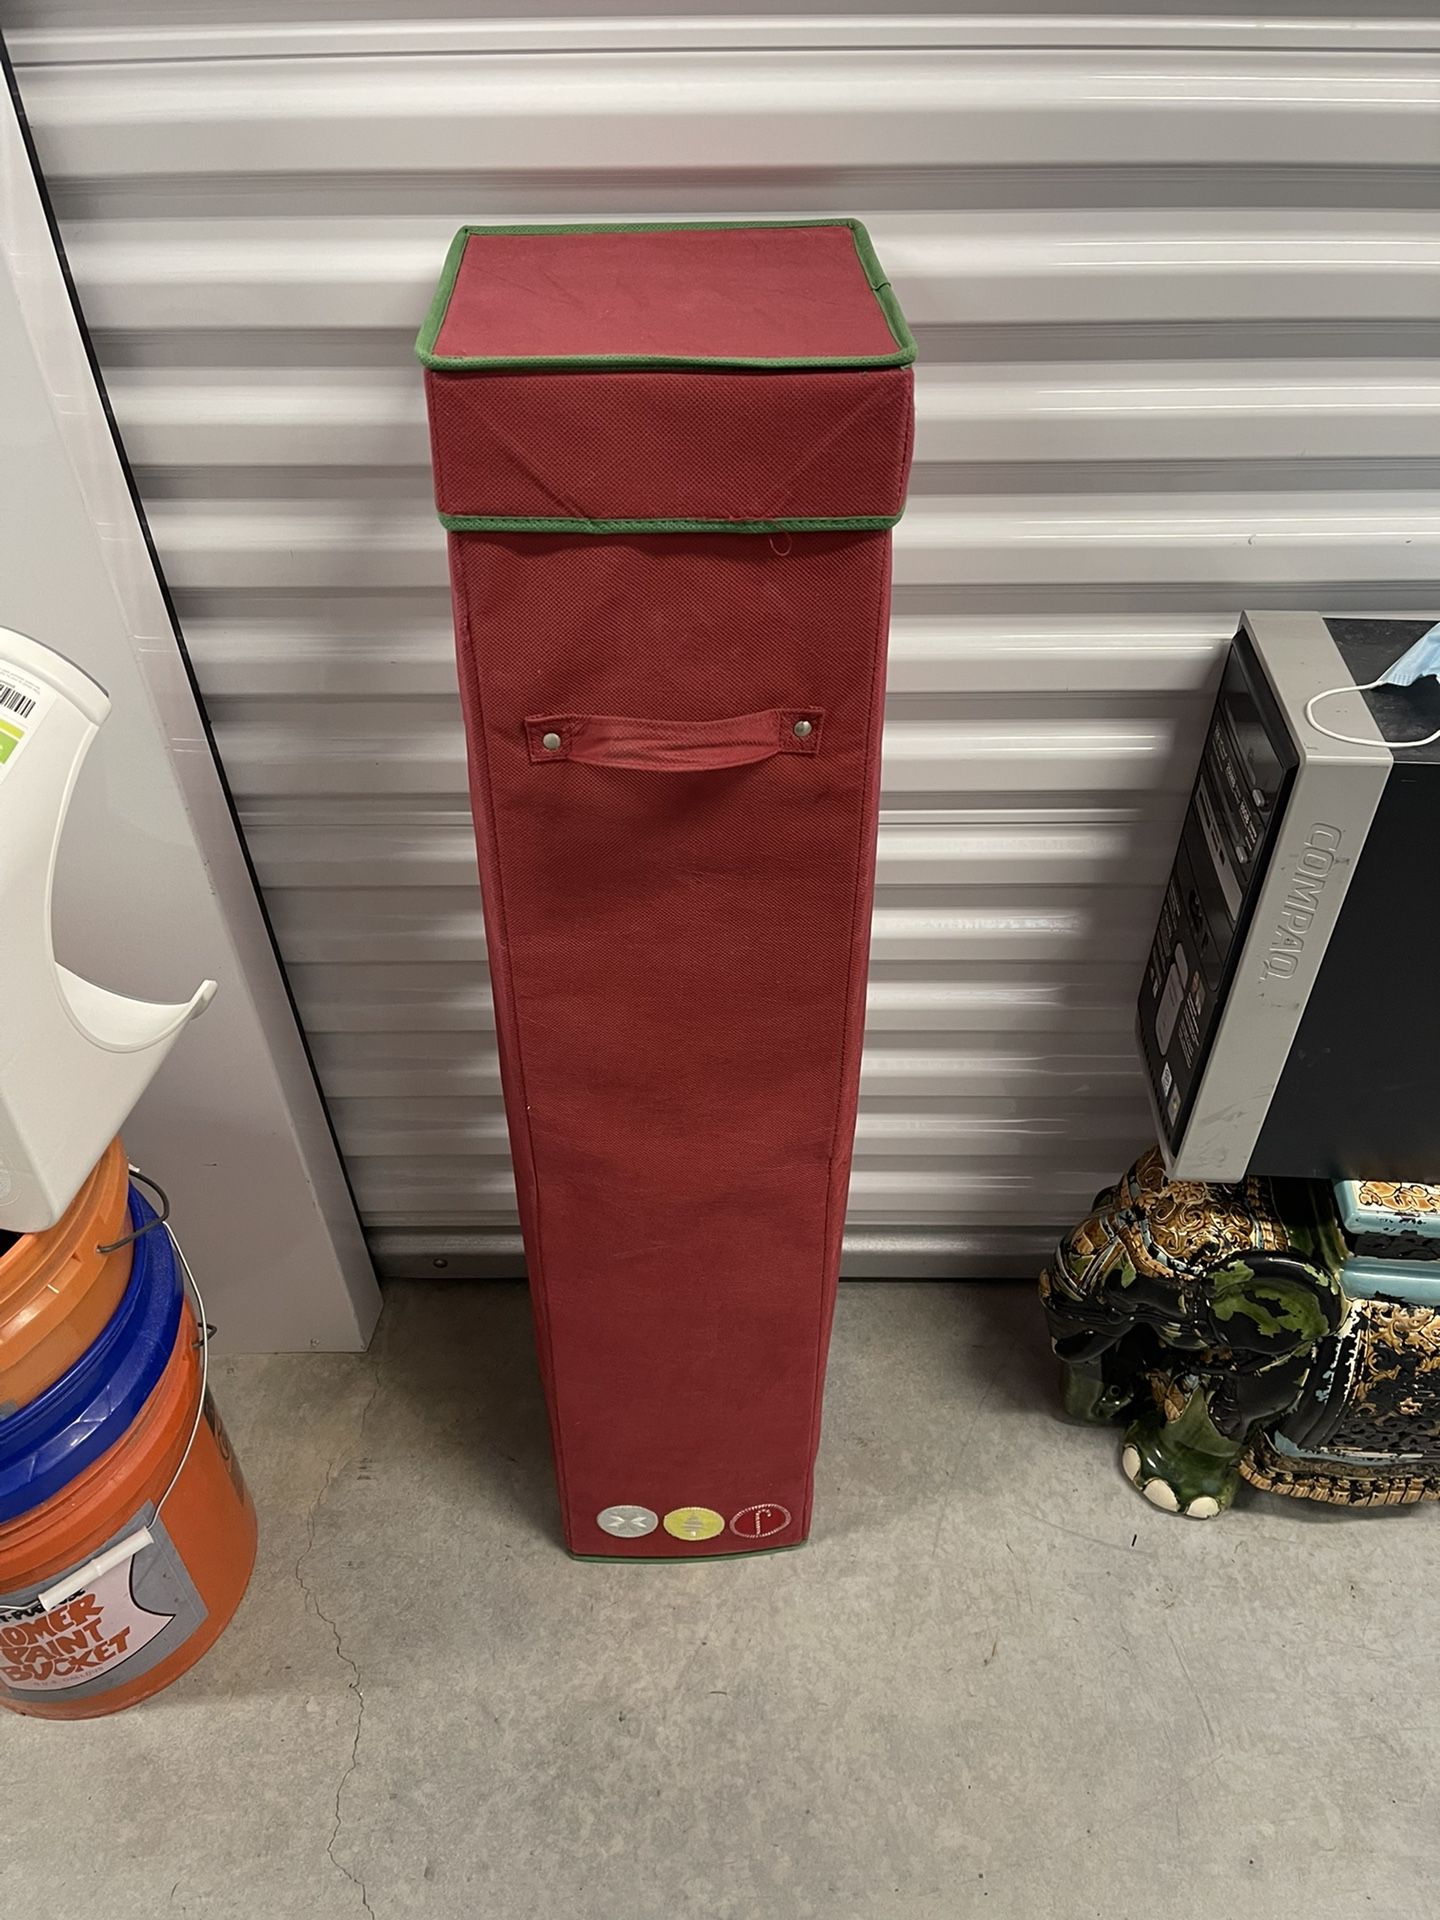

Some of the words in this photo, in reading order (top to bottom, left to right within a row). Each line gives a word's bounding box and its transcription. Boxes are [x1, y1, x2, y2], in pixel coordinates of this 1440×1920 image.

[1259, 822, 1342, 981] COMPAQ
[0, 1594, 104, 1648] OMER
[2, 1617, 104, 1665] PAINT
[1, 1626, 130, 1682] BUCKET
